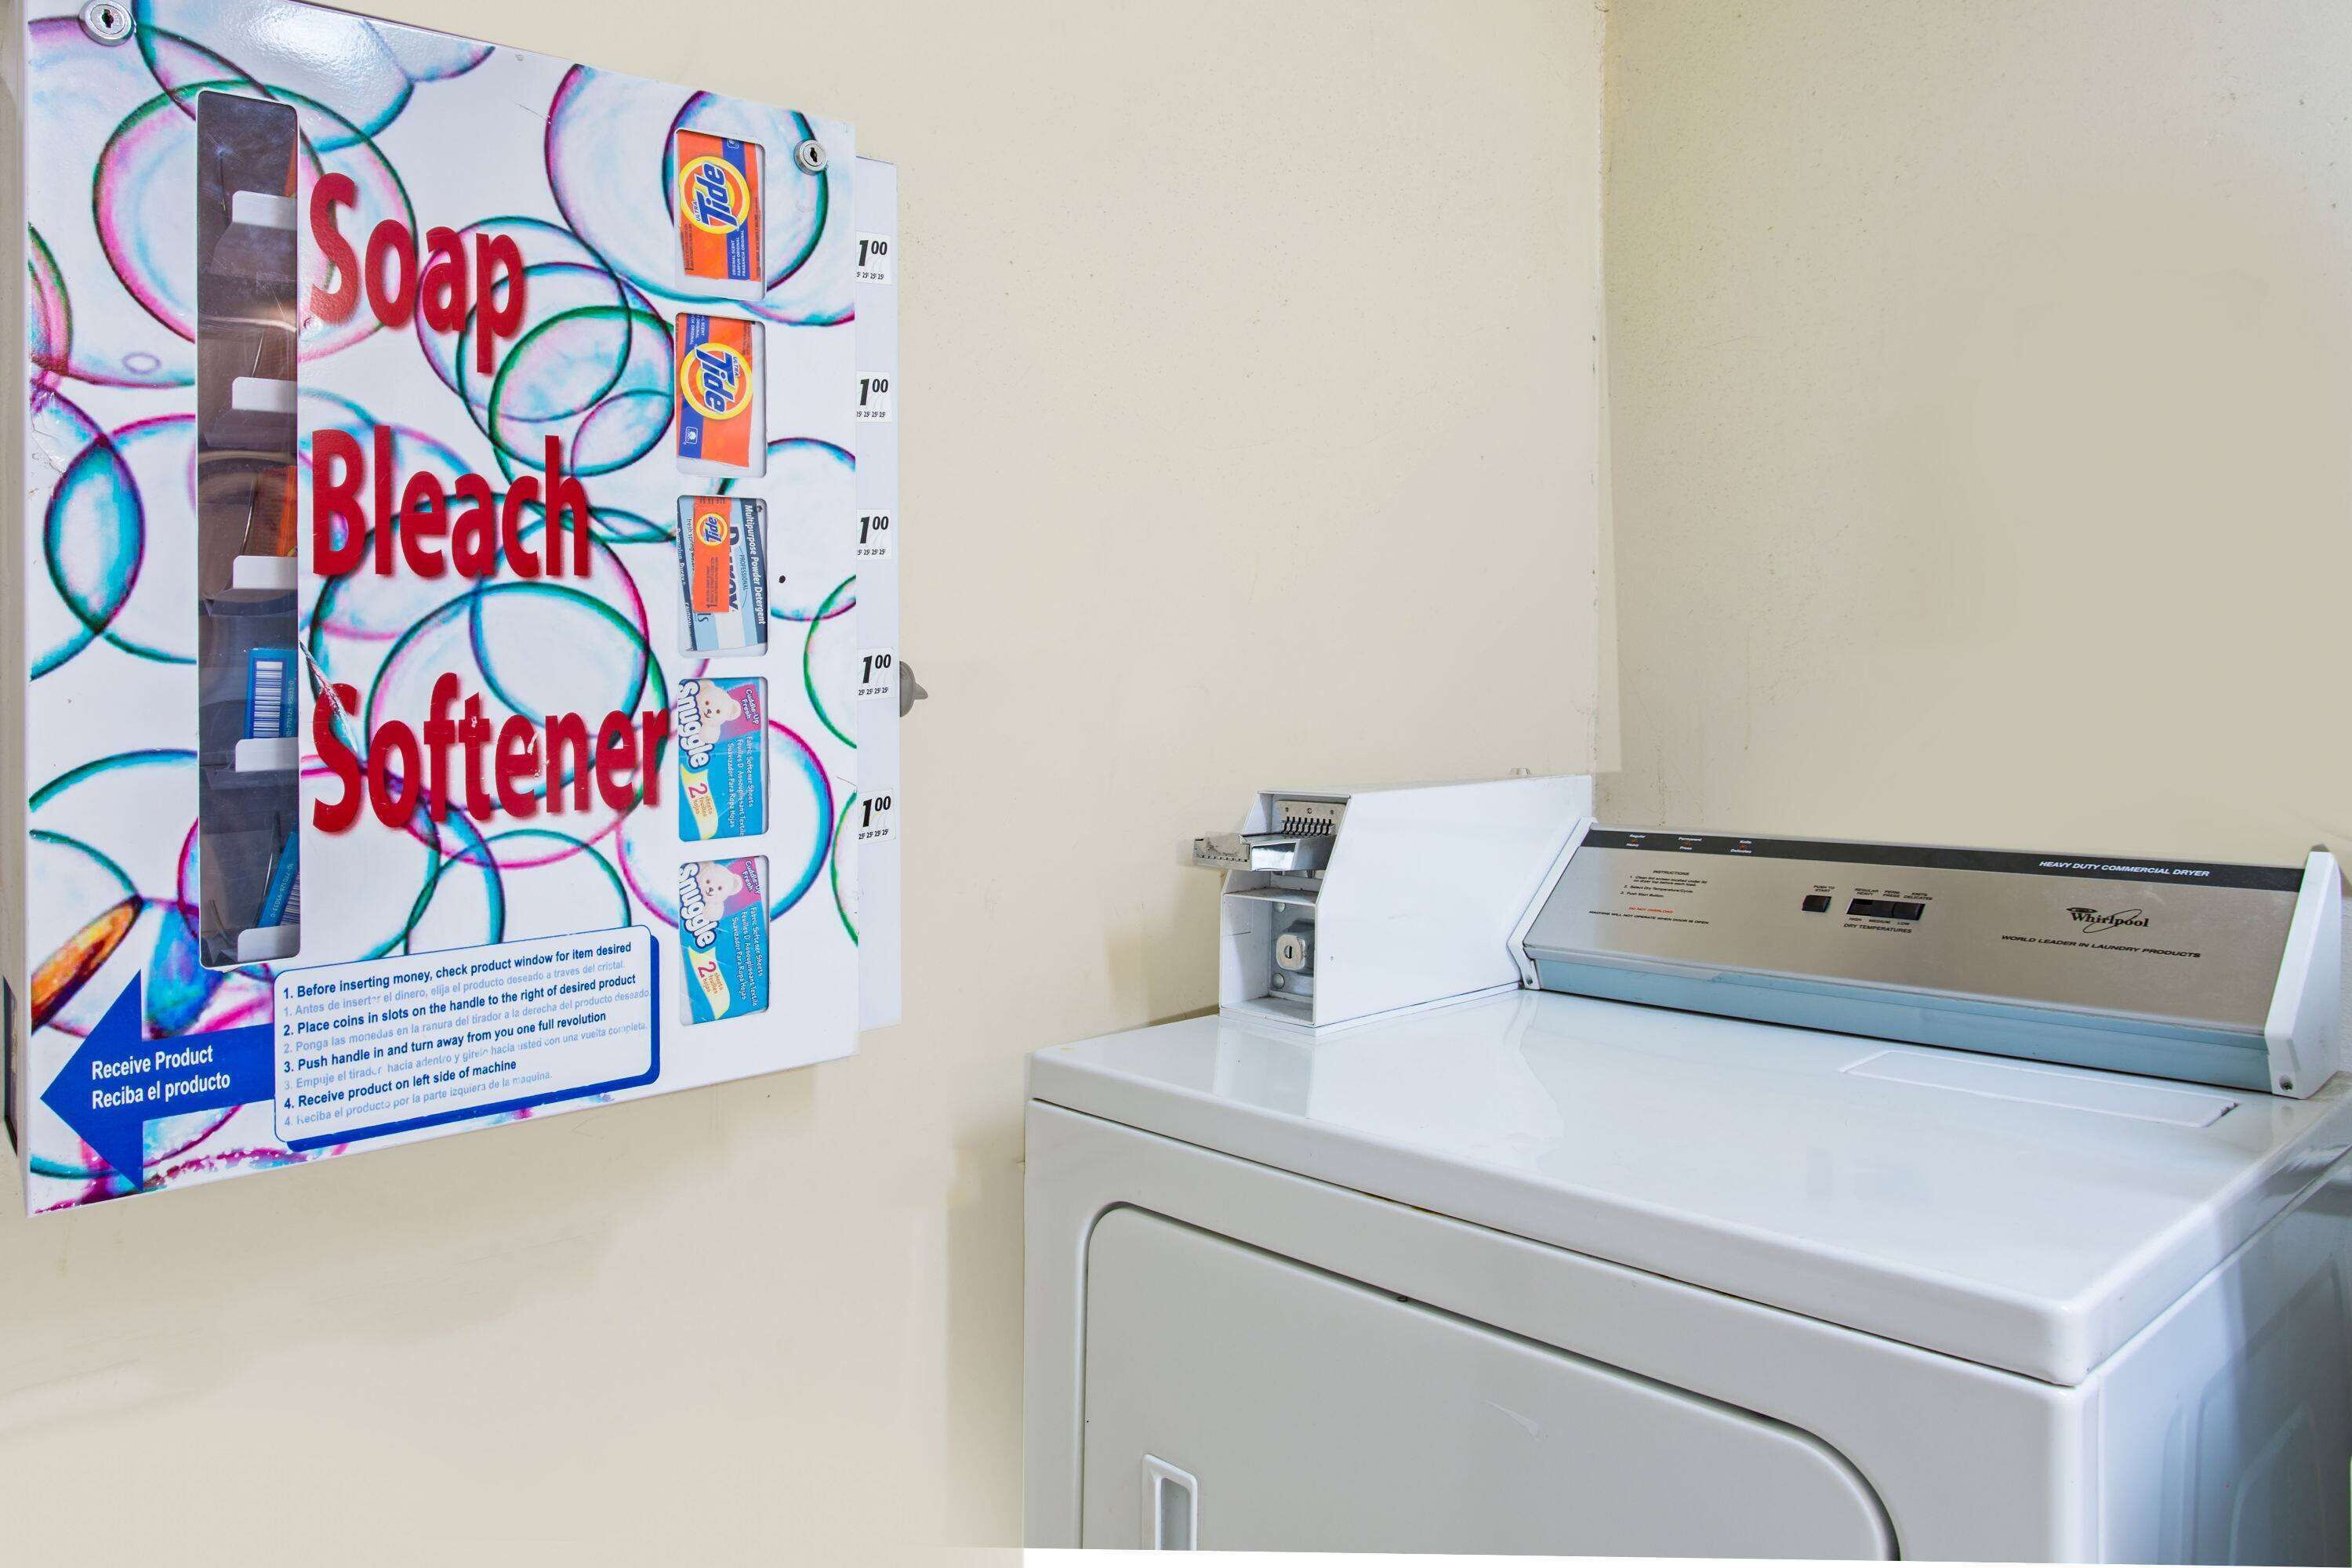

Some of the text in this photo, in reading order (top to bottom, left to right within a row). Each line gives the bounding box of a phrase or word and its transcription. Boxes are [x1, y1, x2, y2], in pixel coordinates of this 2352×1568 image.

[692, 201, 701, 222] ULTRA
[695, 163, 738, 227] Tide
[310, 172, 524, 373] Soap
[695, 349, 734, 412] Tide
[312, 426, 587, 577] Bleach
[705, 517, 721, 542] Tide
[739, 554, 748, 591] PROFESSIONAL
[745, 505, 765, 624] Multipurpose Powder Detergent
[678, 681, 713, 768] Snuggle
[742, 699, 751, 719] Fresh
[313, 673, 668, 833] Softener
[688, 783, 707, 798] 2
[742, 871, 753, 891] Fresh
[2101, 865, 2170, 874] COMMERCIAL
[679, 864, 717, 947] Snuggle
[2071, 912, 2150, 927] Whirlpool
[283, 942, 630, 999] 1. Before inserting money, check product window for item desired
[698, 961, 716, 978] 2
[2092, 944, 2140, 953] LAUNDRY
[2142, 948, 2201, 957] PRODUCTS
[283, 974, 635, 1036] 2. Place coins in slots on the handle to the right of desired product
[92, 1046, 213, 1080] Receive Product
[284, 1012, 605, 1073] 3. Push handle in and turn away from you one full revolution
[93, 1072, 230, 1109] Reciba el producto
[284, 1061, 516, 1109] 4. Receive product on left side of machine
